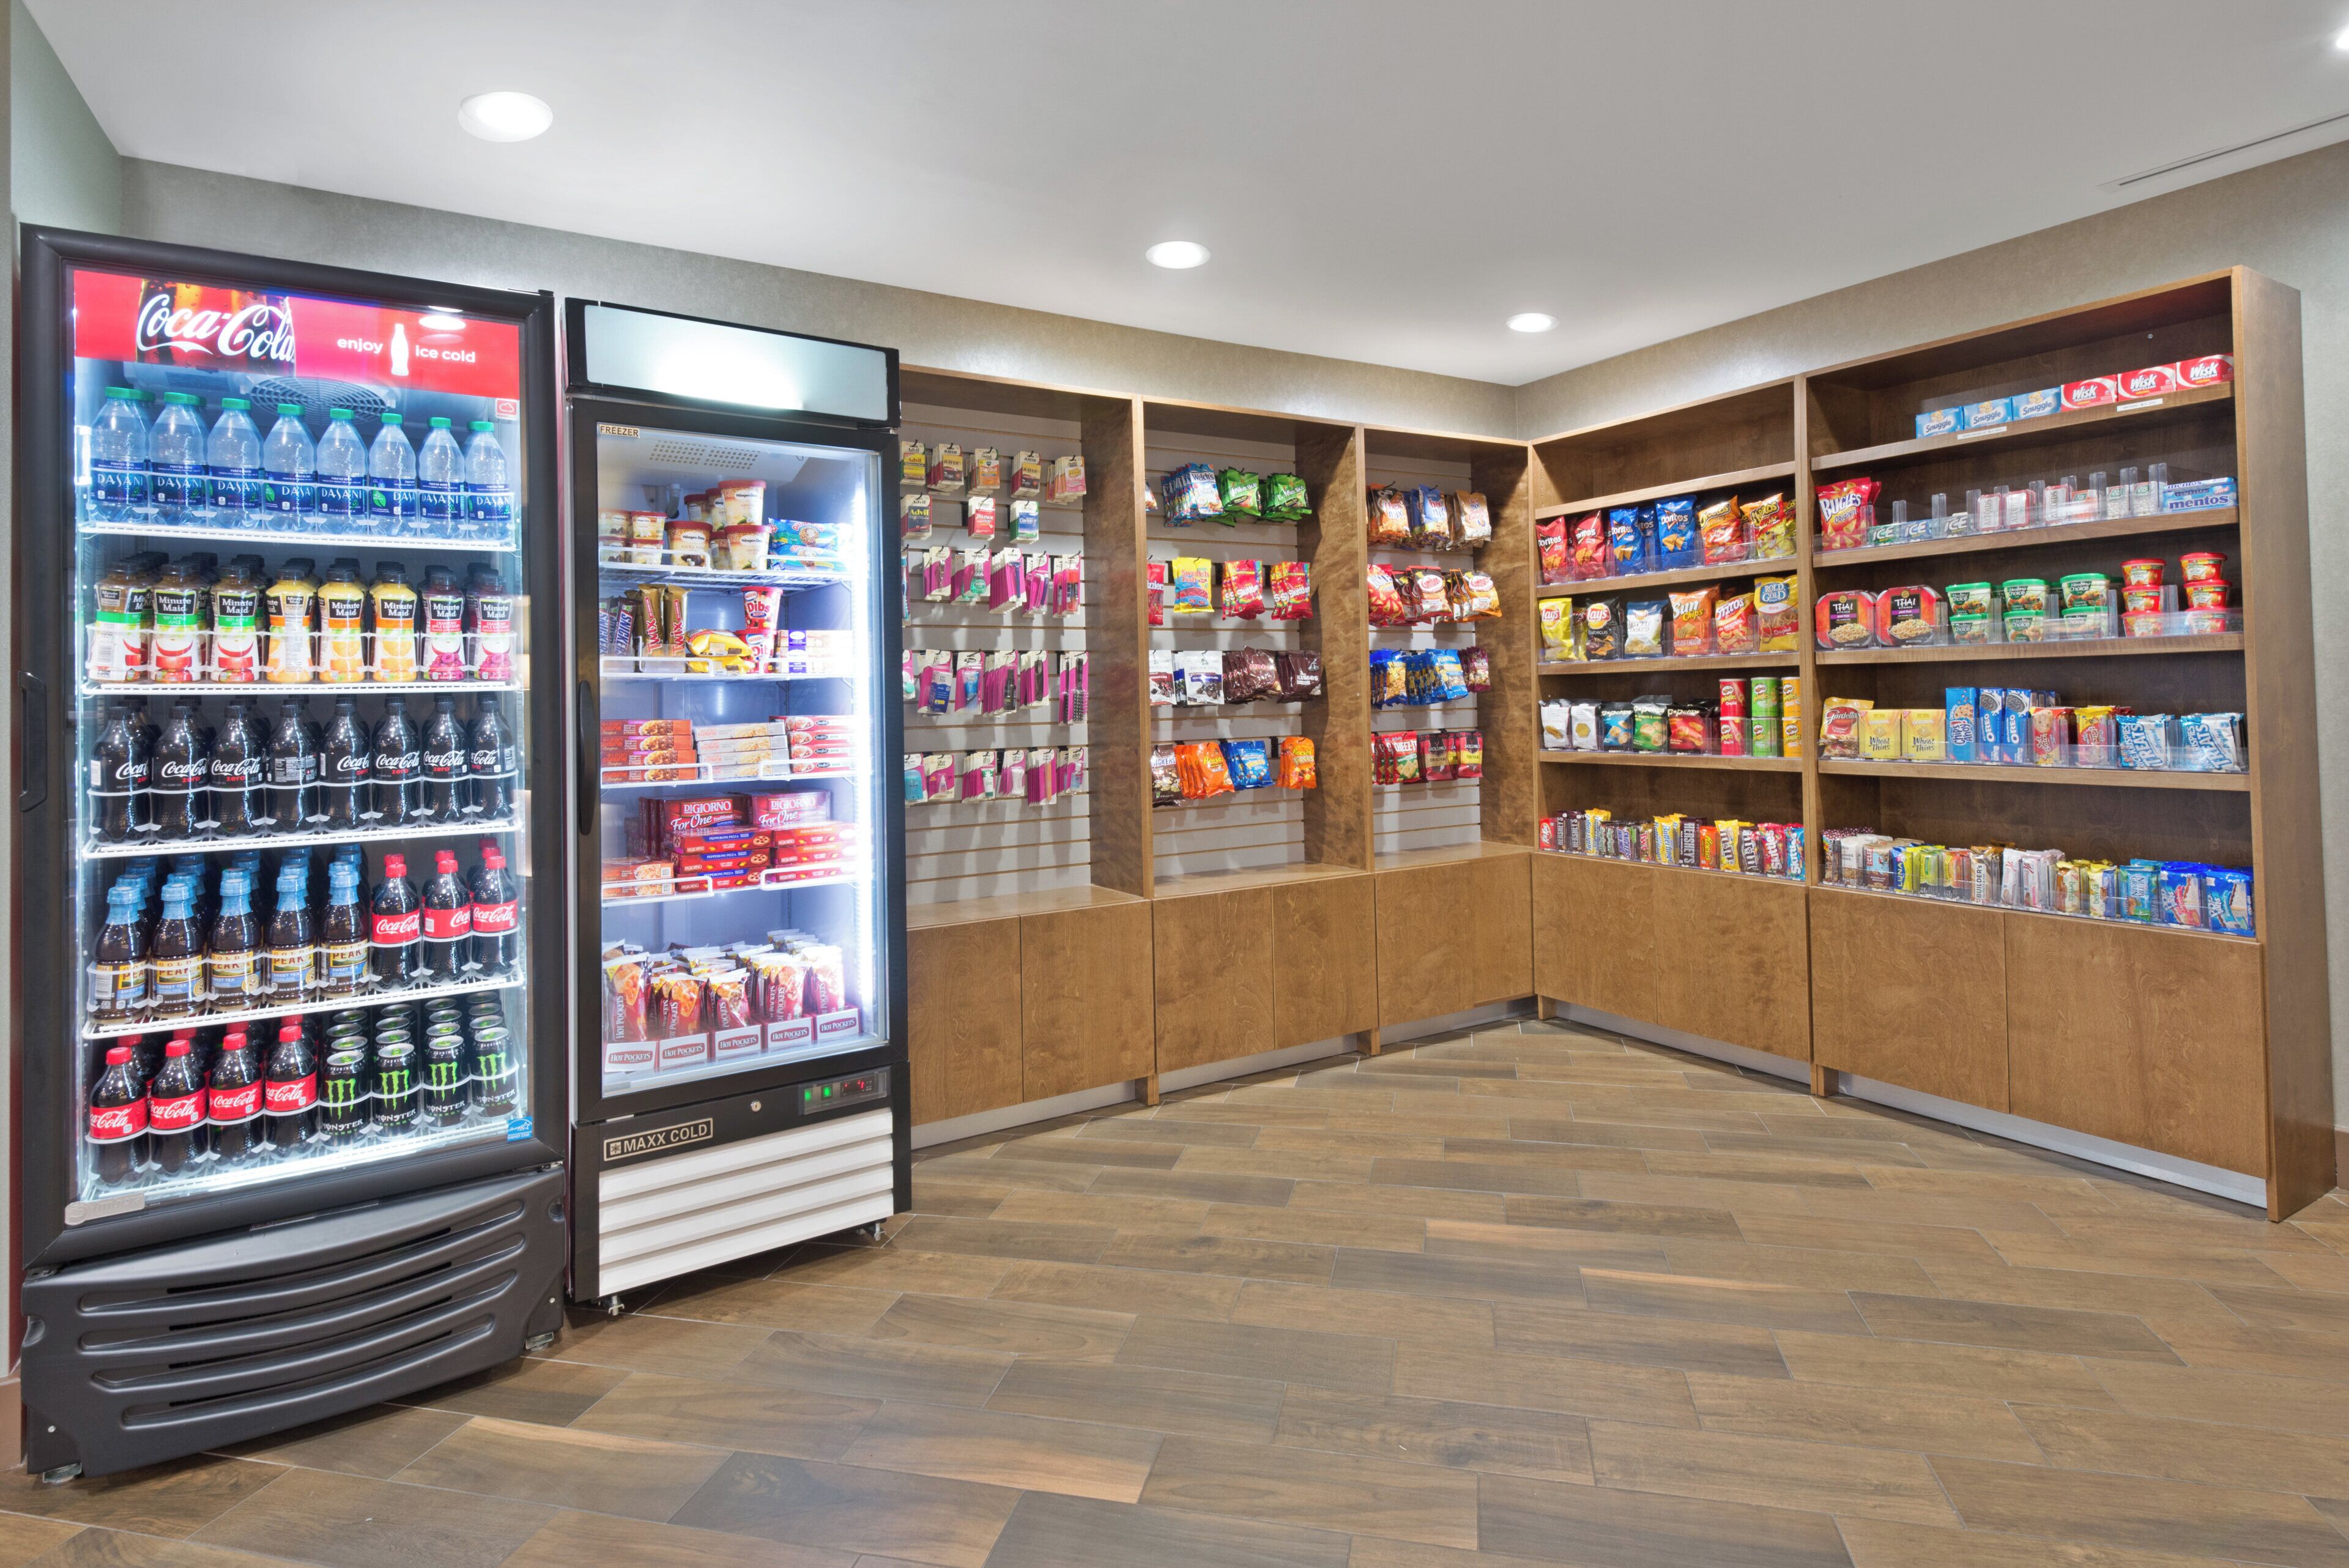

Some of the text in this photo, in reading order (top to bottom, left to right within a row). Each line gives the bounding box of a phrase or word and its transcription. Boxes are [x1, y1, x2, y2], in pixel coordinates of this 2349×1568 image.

[136, 294, 295, 363] Coca-Cola
[336, 335, 476, 363] enjoy ice cold
[2022, 400, 2052, 415] Snuggle
[1973, 411, 2002, 425] Snuggle
[600, 426, 638, 436] FREEZER
[1925, 418, 1952, 433] Snuggle
[98, 472, 143, 488] DASANI
[157, 475, 202, 489] DASANI
[1192, 472, 1215, 482] Welch's
[217, 480, 259, 494] DASANI
[2167, 481, 2203, 489] mentos
[321, 489, 362, 501] DASANI
[421, 492, 459, 505] DASANI
[2169, 494, 2230, 510] mentos
[1819, 493, 1863, 522] BUGLES
[1661, 515, 1689, 525] Doritos
[1944, 516, 1968, 532] ICE
[1611, 526, 1635, 535] Doritos
[1872, 527, 1894, 541] ICE
[1905, 521, 1928, 537] ICE
[1537, 535, 1562, 548] Doritos
[1765, 583, 1785, 593] ROLD
[158, 596, 192, 606] Minute
[221, 598, 254, 608] Minute
[1762, 592, 1786, 603] GOLD
[1894, 598, 1917, 608] THAI
[163, 604, 188, 612] Maid
[226, 606, 251, 614] Maid
[331, 601, 361, 611] Minute
[336, 608, 358, 617] Maid
[384, 601, 414, 611] Minute
[388, 608, 410, 617] Maid
[432, 602, 461, 612] Minute
[483, 603, 510, 612] Minute
[747, 600, 772, 614] Dibs
[1673, 600, 1700, 620] Sun
[1716, 597, 1744, 620] Fritos
[1832, 603, 1854, 611] THAI
[436, 609, 458, 618] Maid
[486, 611, 507, 619] Maid
[1541, 608, 1560, 622] Lay's
[1586, 608, 1608, 622] Lay's
[1682, 608, 1704, 622] Chips
[615, 612, 634, 656] SNICKERS
[647, 619, 663, 653] TWIX
[672, 621, 686, 655] TWIX
[1721, 696, 1736, 704] Pringles
[1668, 708, 1700, 717] popchips
[1983, 713, 1995, 743] OREO
[2011, 715, 2021, 744] OREO
[1869, 736, 1890, 746] Wheat
[1872, 743, 1891, 753] Thins
[1913, 736, 1935, 746] Wheat
[1913, 743, 1935, 753] Thins
[2130, 723, 2164, 768] TREATS
[211, 756, 261, 776] Coca-Cola
[670, 817, 689, 832] For
[689, 814, 713, 828] One
[757, 809, 798, 827] For One
[1684, 822, 1695, 864] HERSHEY'S
[1705, 835, 1713, 861] Reese's
[1765, 830, 1783, 871] Skittles
[1790, 832, 1802, 875] Skittles
[473, 904, 516, 923] Coca-Cola
[273, 954, 305, 965] PEAK
[332, 949, 361, 960] PEAK
[615, 995, 625, 1039] HOT POCKETS
[670, 1001, 679, 1030] POCKETS
[718, 1001, 727, 1028] POCKETS
[820, 1018, 856, 1032] HOT POCKETS
[772, 1027, 809, 1041] HOT POCKETS
[718, 1035, 757, 1050] HOT POCKETS
[610, 1052, 651, 1063] HOT POCKETS
[664, 1044, 703, 1059] HOT POCKETS
[213, 1088, 258, 1108] Coca-Cola
[476, 1088, 516, 1104] MONSTER
[426, 1100, 466, 1114] MONSTER
[375, 1108, 417, 1123] MONSTER
[322, 1118, 364, 1132] MONSTER
[623, 1124, 708, 1153] MAXX COLD
